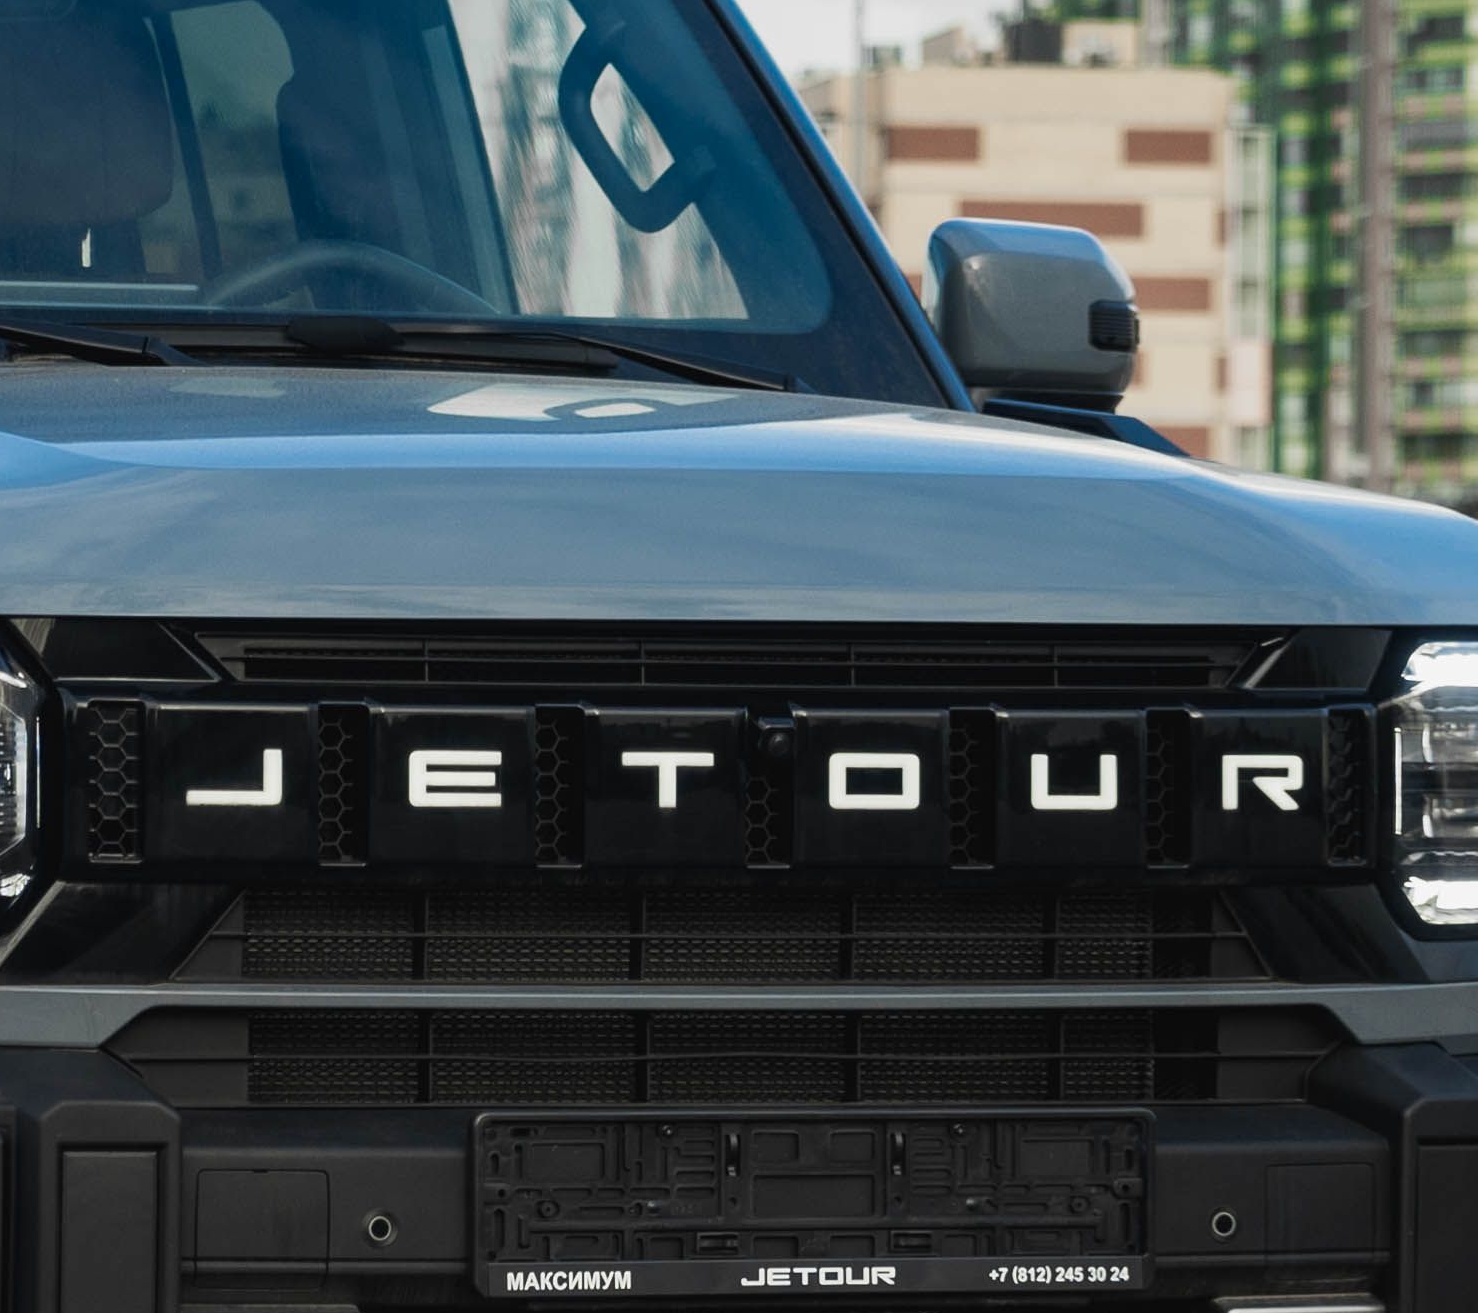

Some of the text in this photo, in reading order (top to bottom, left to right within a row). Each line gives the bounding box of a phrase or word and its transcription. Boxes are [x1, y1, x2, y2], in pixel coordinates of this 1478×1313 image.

[185, 748, 1304, 811] JETOUR
[506, 1271, 632, 1291] МАКСИМУМ
[740, 1266, 896, 1286] JETOUR
[988, 1265, 1130, 1284] +7 (812) 245 30 24
